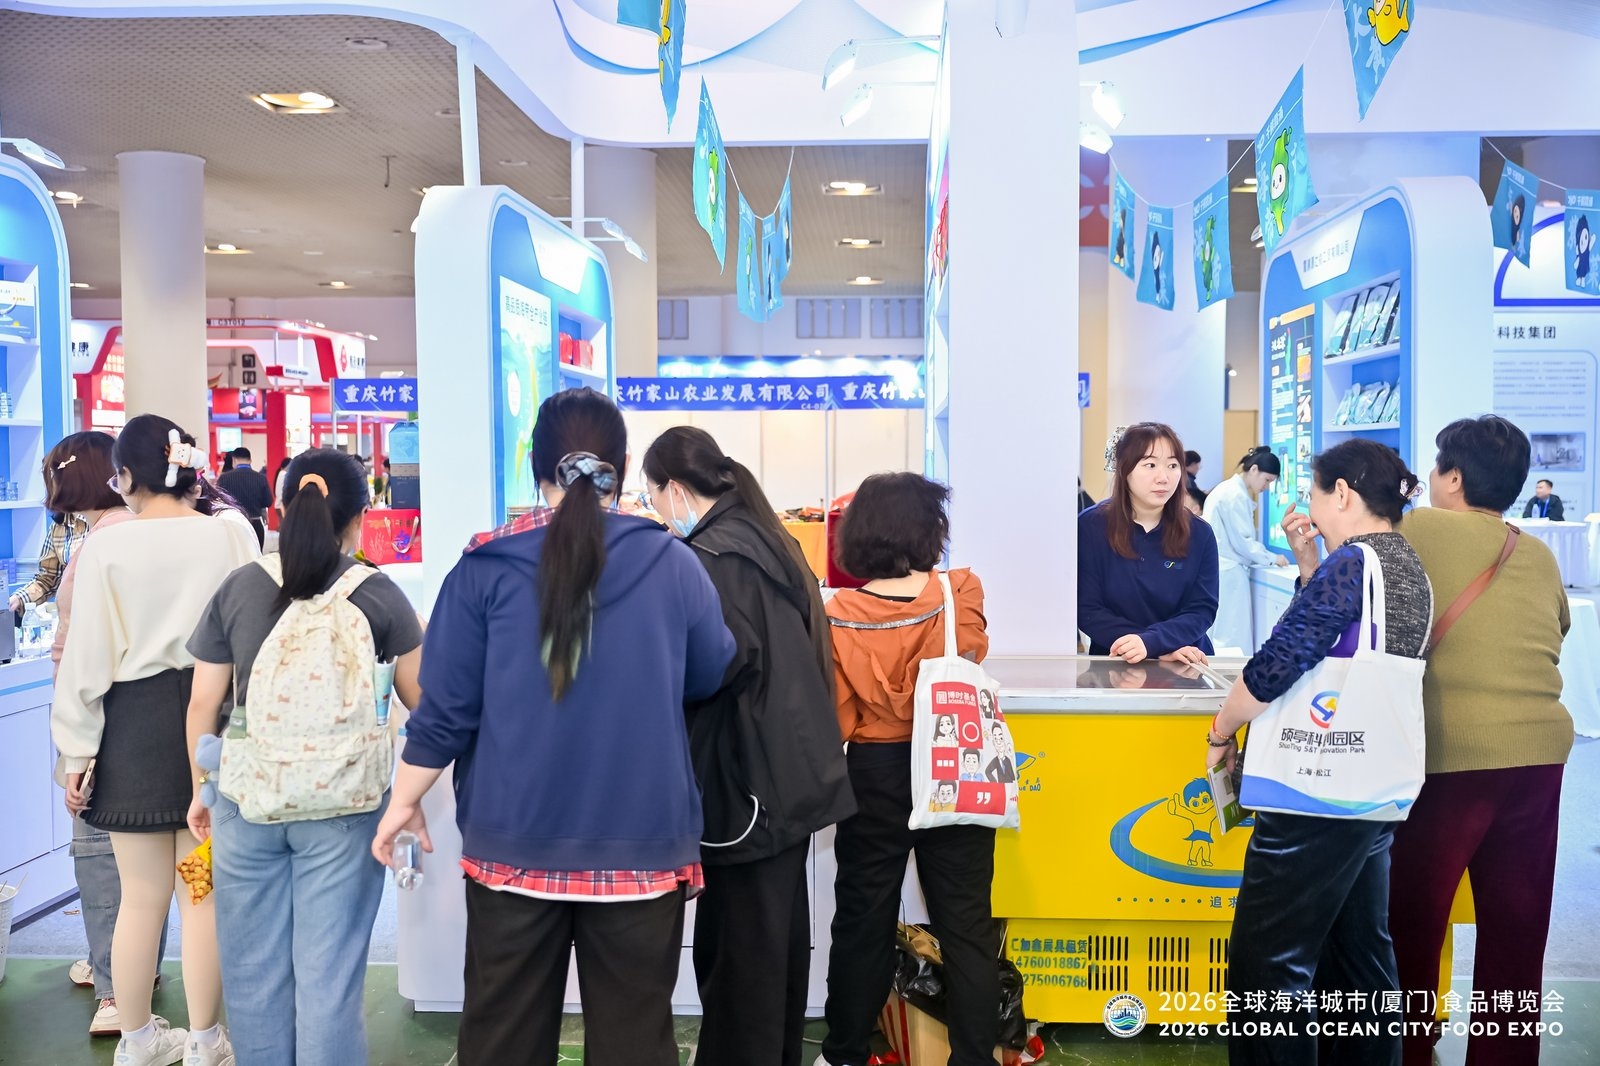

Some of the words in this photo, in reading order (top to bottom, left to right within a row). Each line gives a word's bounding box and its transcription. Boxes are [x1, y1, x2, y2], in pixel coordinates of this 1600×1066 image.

[1497, 326, 1557, 339] 科技集团
[343, 383, 415, 403] 重庆竹家
